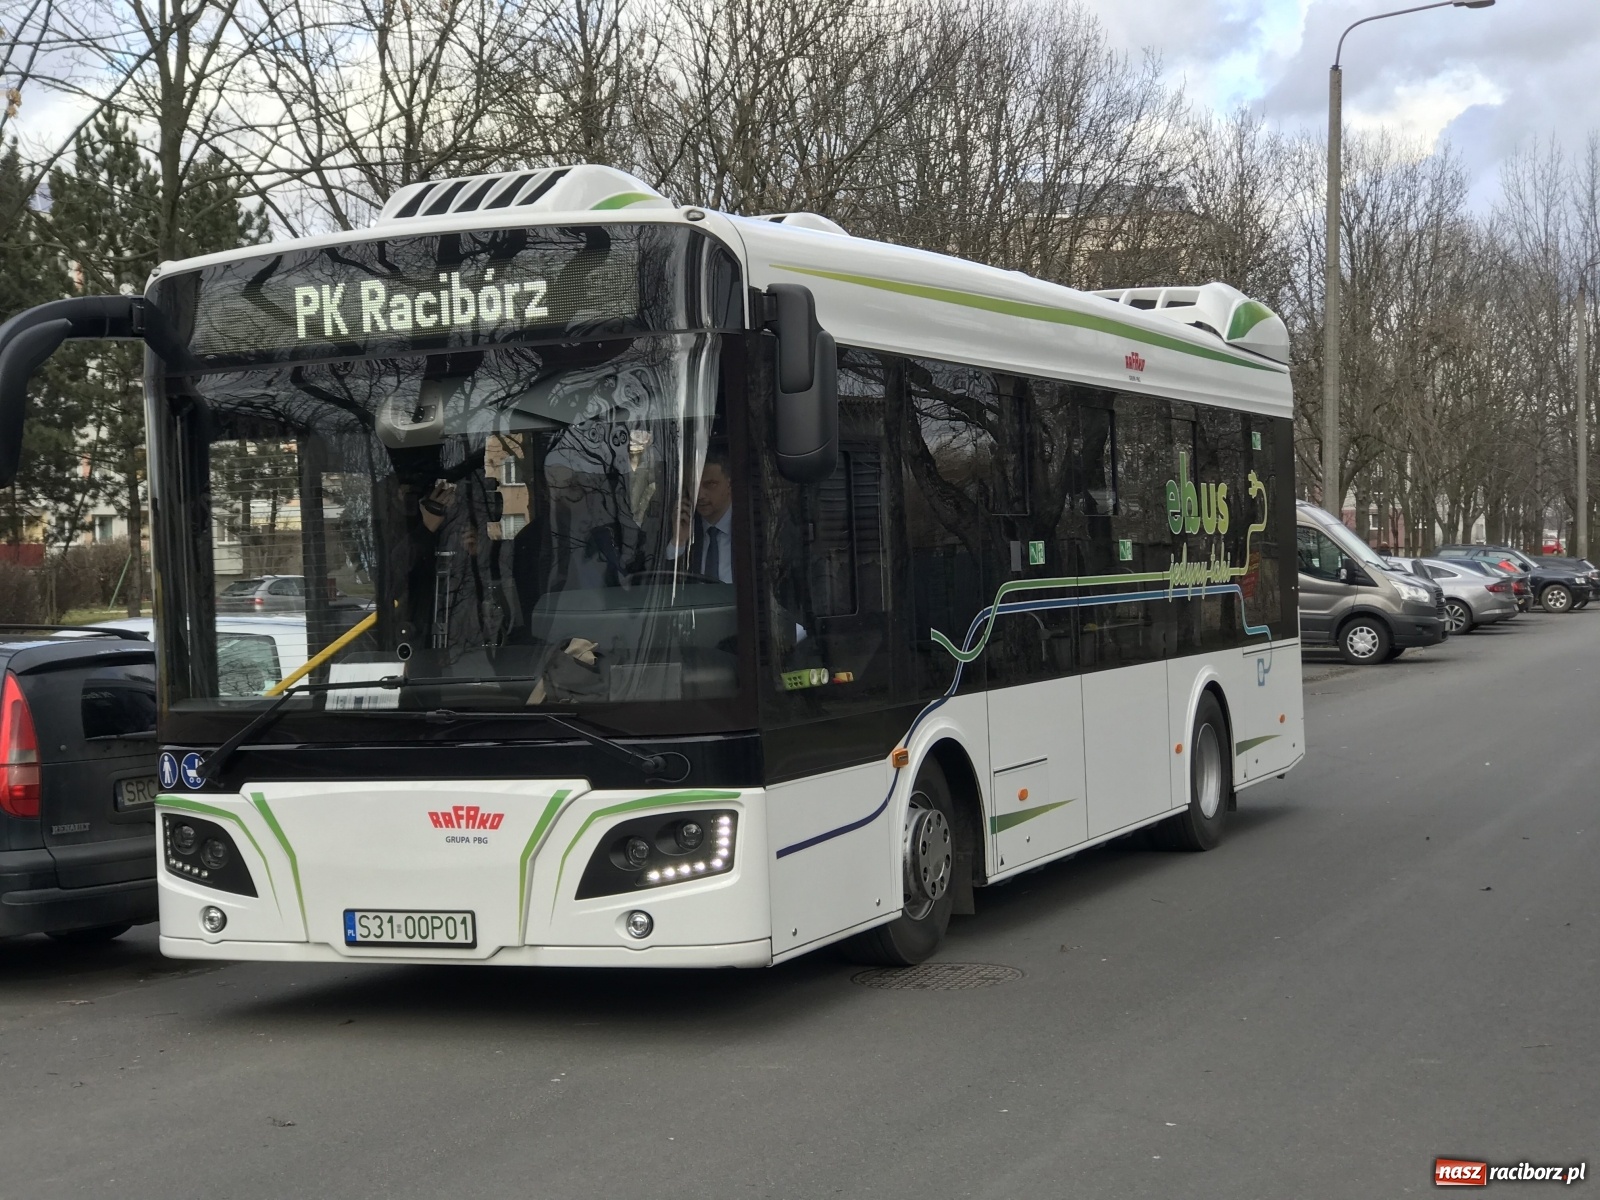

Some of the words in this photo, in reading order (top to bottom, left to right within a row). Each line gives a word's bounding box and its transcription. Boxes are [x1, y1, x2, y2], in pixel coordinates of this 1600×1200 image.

[294, 283, 349, 338] PK
[360, 268, 548, 333] Racibórz
[1166, 451, 1230, 535] ebus
[51, 822, 91, 835] RENAULT
[428, 805, 505, 830] RAFAKO
[445, 835, 471, 844] GRUPA
[472, 836, 489, 845] PBG
[358, 914, 394, 939] S31
